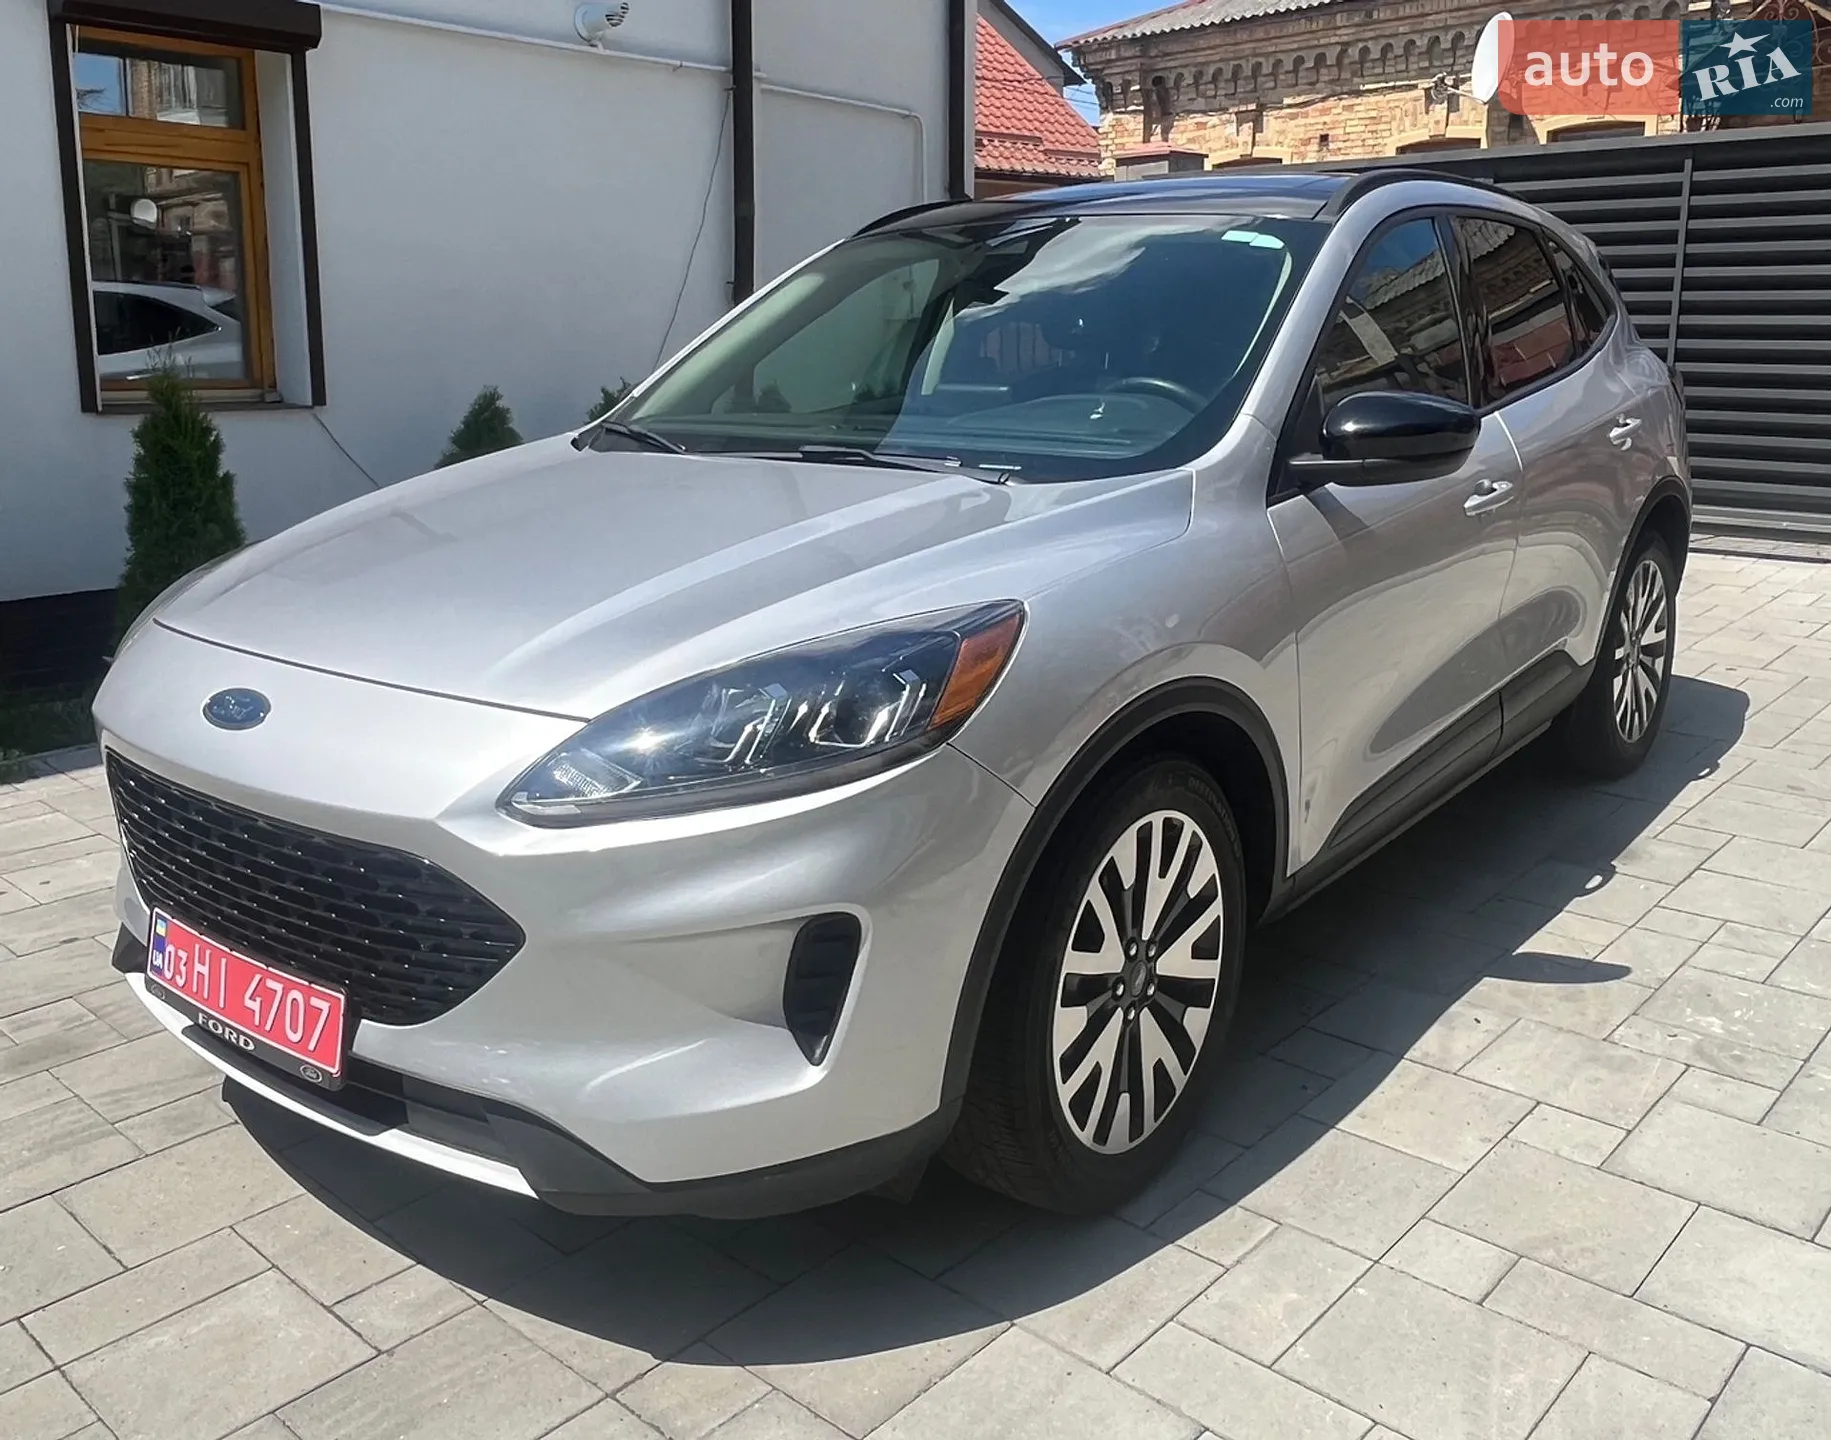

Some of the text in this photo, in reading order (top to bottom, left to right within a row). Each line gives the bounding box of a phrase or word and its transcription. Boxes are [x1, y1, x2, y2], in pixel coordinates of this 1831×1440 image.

[152, 951, 163, 969] UA
[198, 1012, 255, 1051] FORD
[244, 974, 332, 1053] 4707
